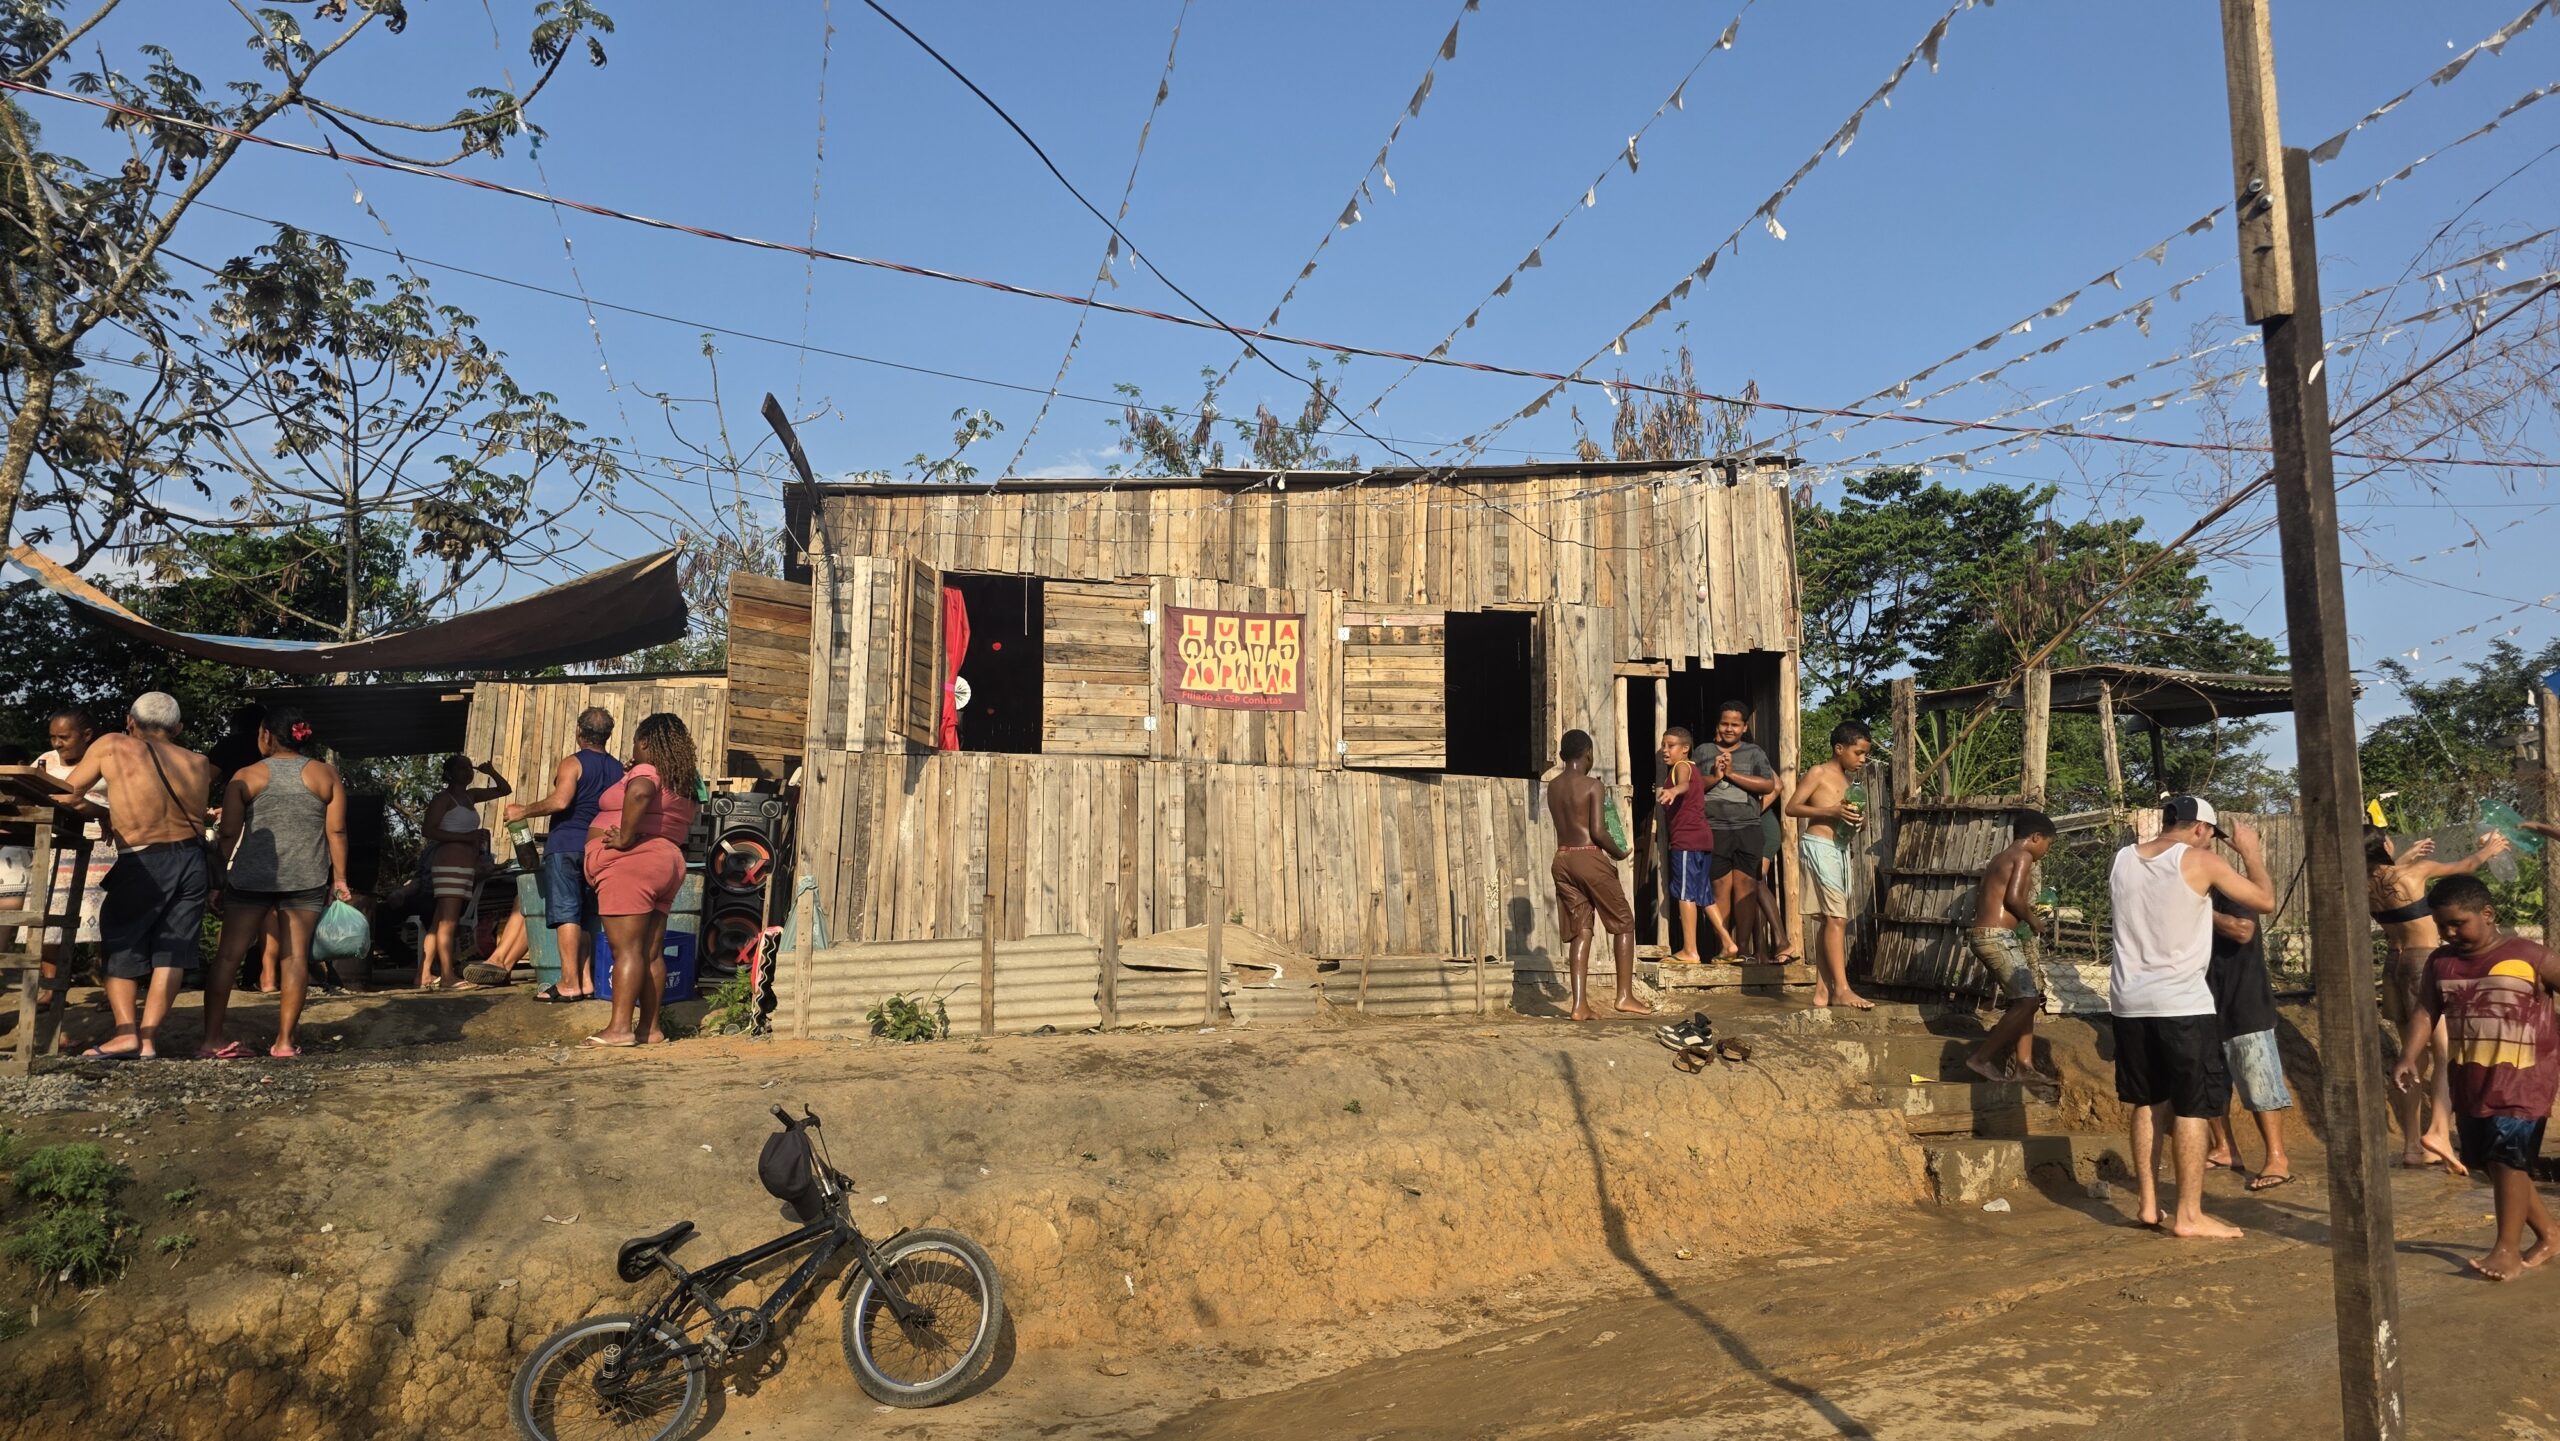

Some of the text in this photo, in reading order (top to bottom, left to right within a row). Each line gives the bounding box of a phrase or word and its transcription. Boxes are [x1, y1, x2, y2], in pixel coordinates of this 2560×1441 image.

[1188, 618, 1295, 640] LUTA
[1187, 665, 1291, 693] POPULAR
[1182, 691, 1213, 702] Filiado
[1224, 694, 1240, 703] CSP
[1243, 695, 1283, 705] Conlutas
